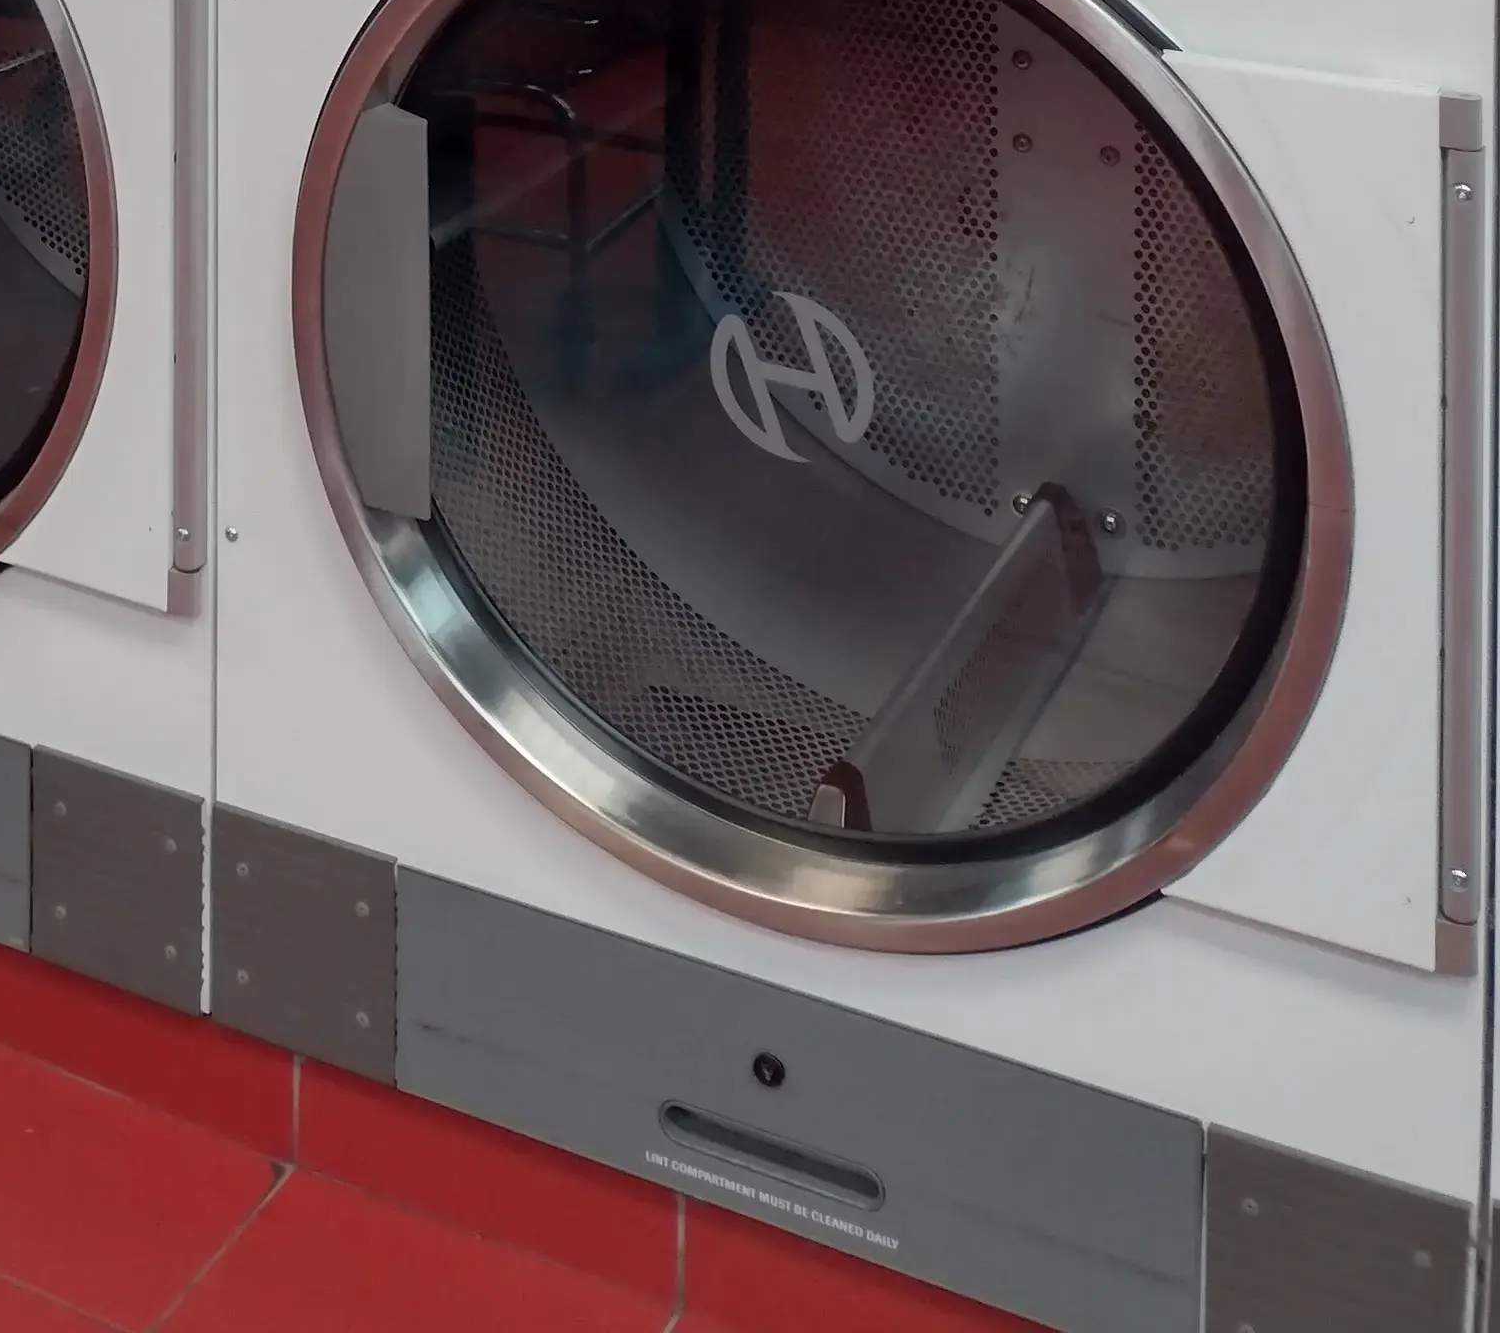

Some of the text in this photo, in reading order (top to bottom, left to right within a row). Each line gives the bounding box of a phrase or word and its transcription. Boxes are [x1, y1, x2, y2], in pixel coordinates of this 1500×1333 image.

[645, 1150, 899, 1249] LINT COMPARTMENT MUST BE CLEANED DAILY
